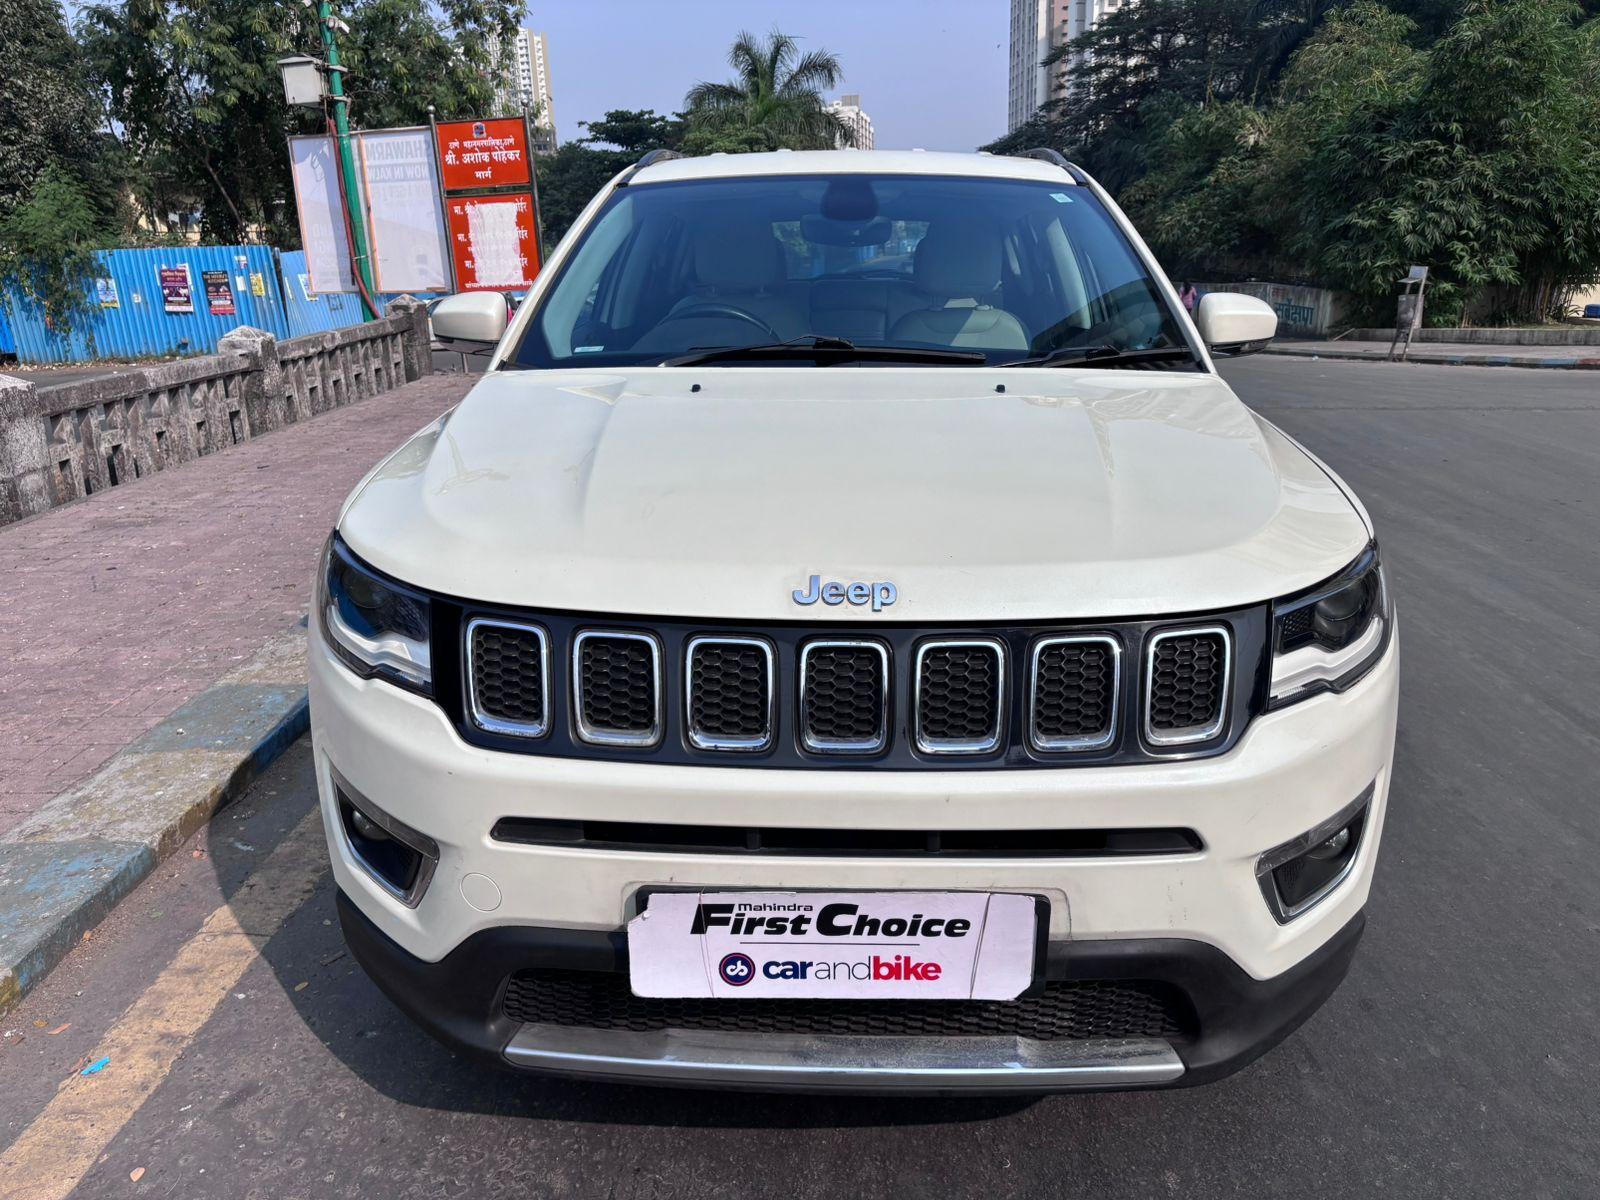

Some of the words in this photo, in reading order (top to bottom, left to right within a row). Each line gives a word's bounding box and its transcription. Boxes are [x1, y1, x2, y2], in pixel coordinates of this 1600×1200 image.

[462, 147, 490, 164] अशोक
[474, 166, 492, 179] मार्ग
[792, 575, 897, 612] Jeep
[738, 903, 814, 912] Mahindra
[690, 903, 812, 936] First
[816, 903, 971, 937] Choice
[762, 954, 942, 981] carandbike
